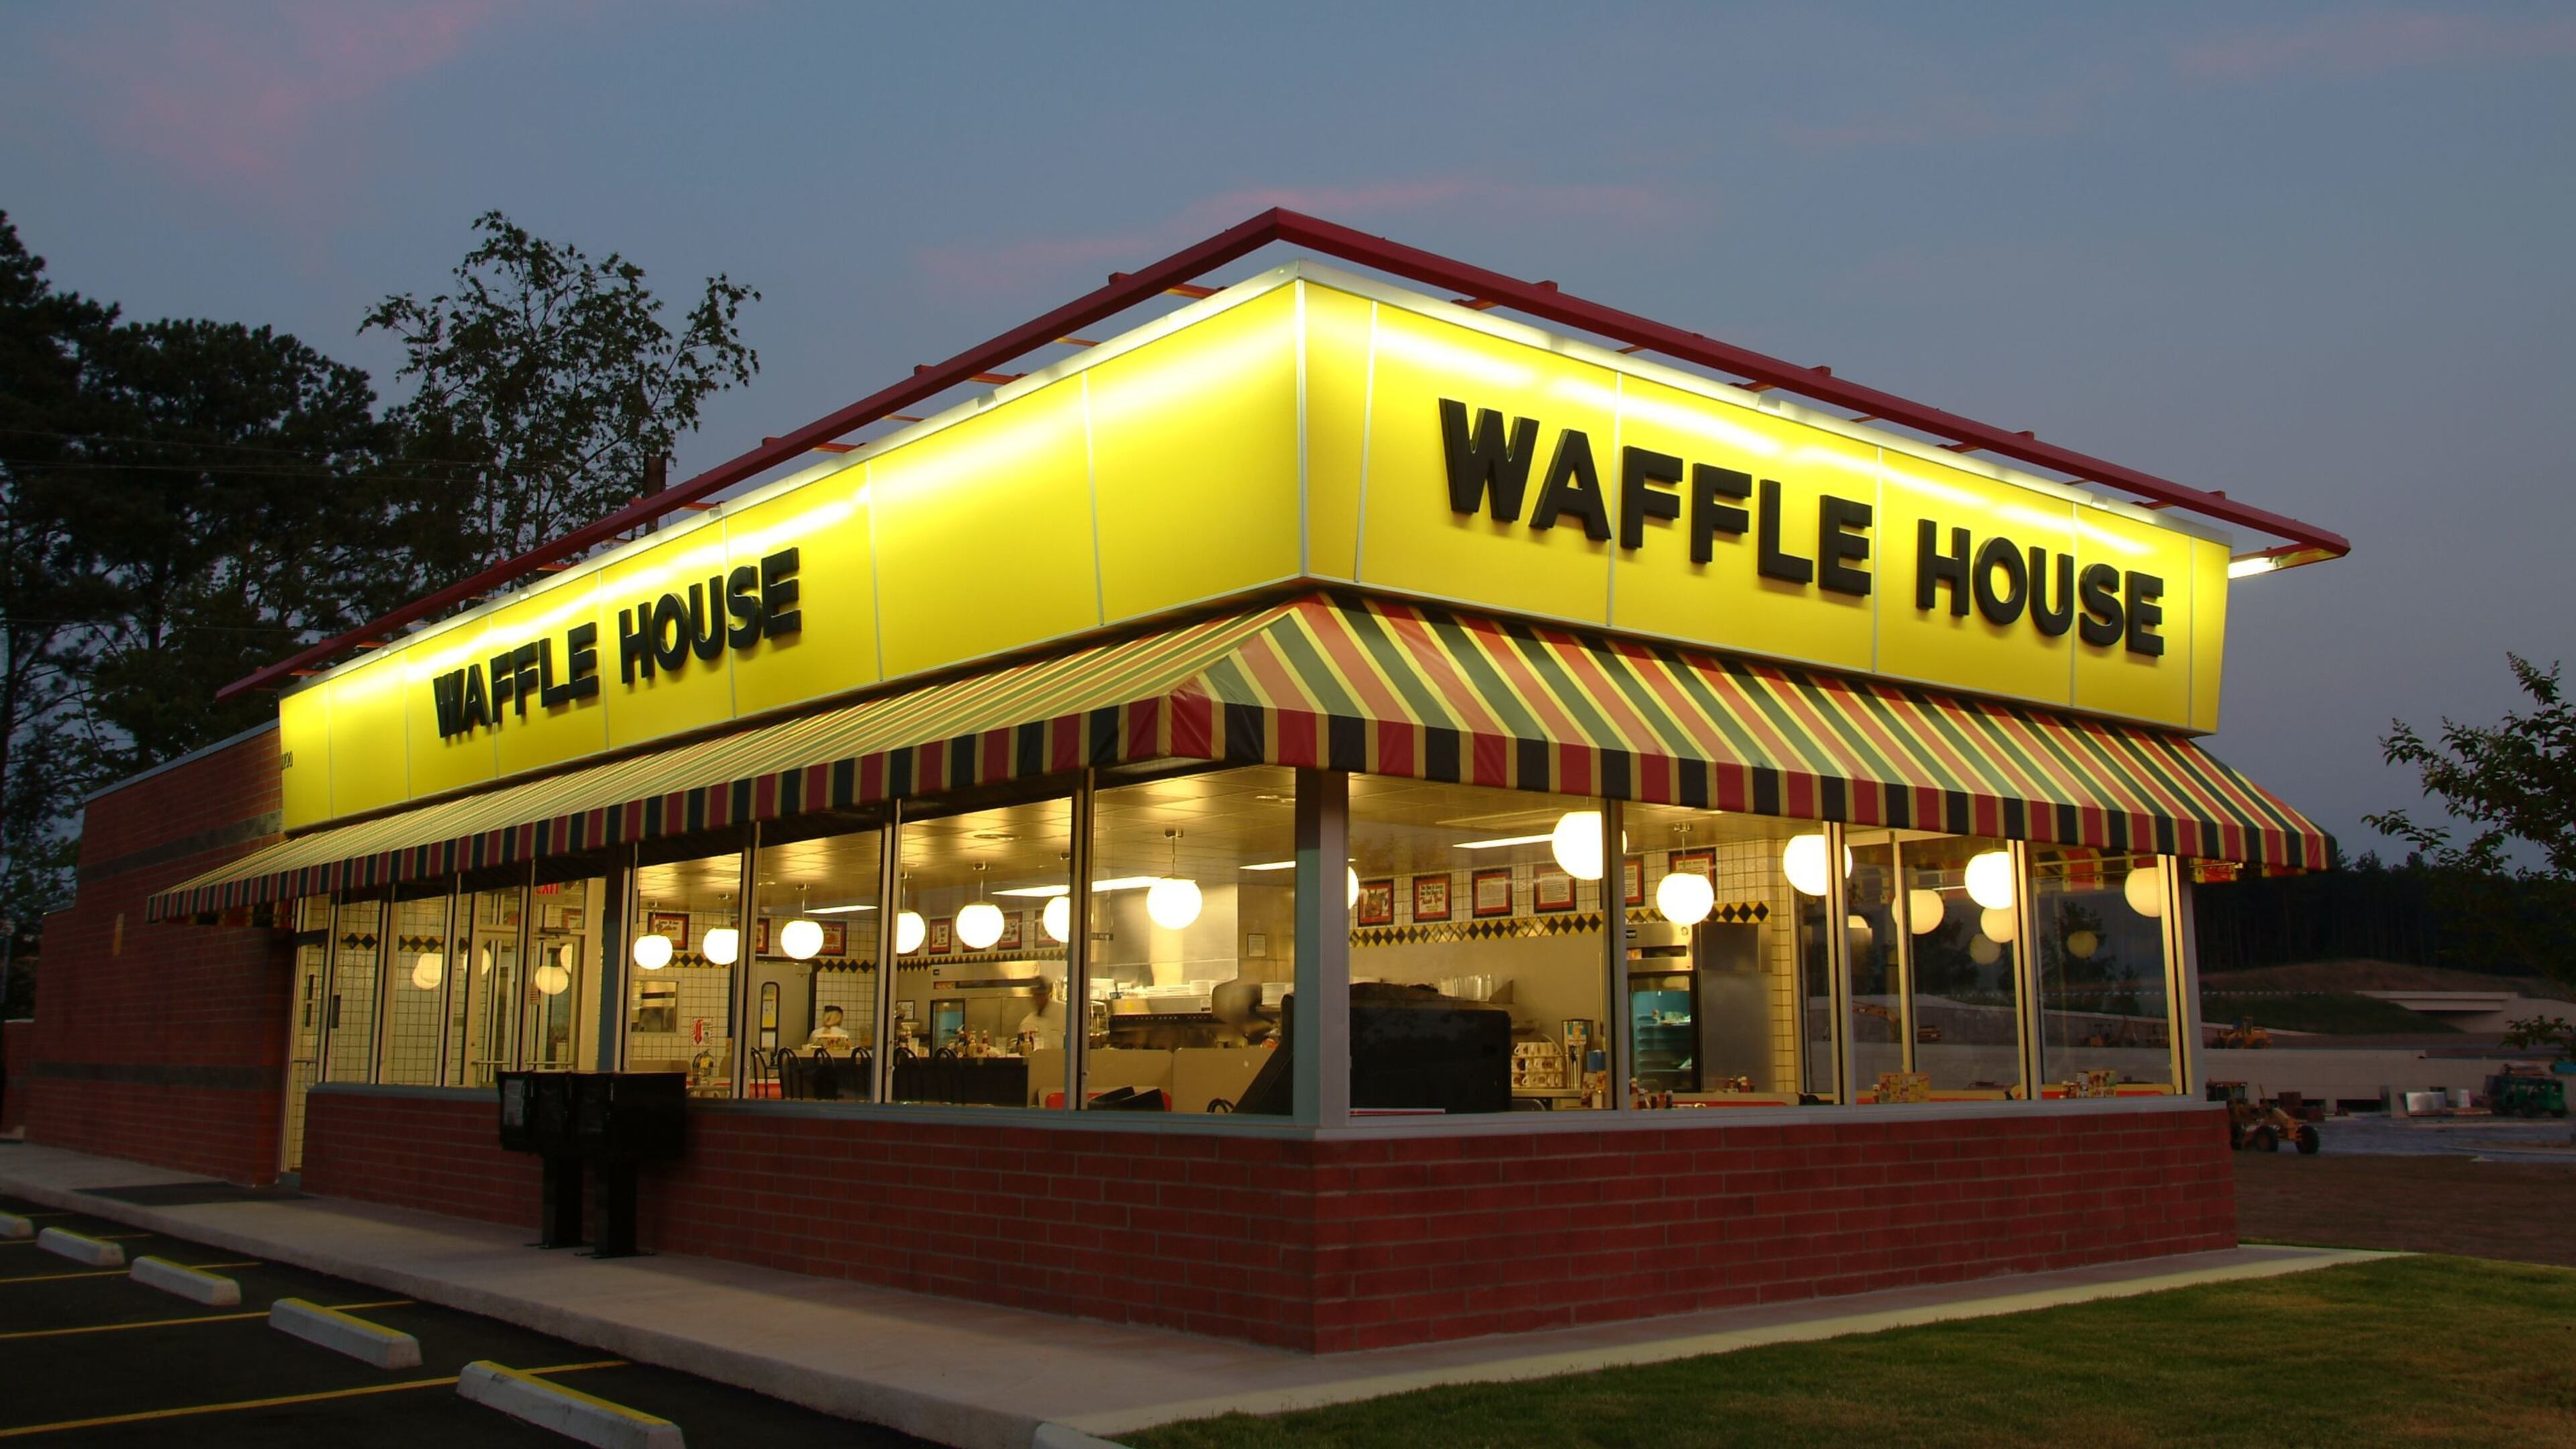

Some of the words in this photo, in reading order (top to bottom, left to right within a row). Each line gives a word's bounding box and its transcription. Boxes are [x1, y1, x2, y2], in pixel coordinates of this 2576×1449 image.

[1439, 397, 1872, 595] WAFFLE
[1916, 519, 2164, 657] HOUSE
[433, 622, 600, 739] WAFFLE
[619, 547, 802, 684] HOUSE
